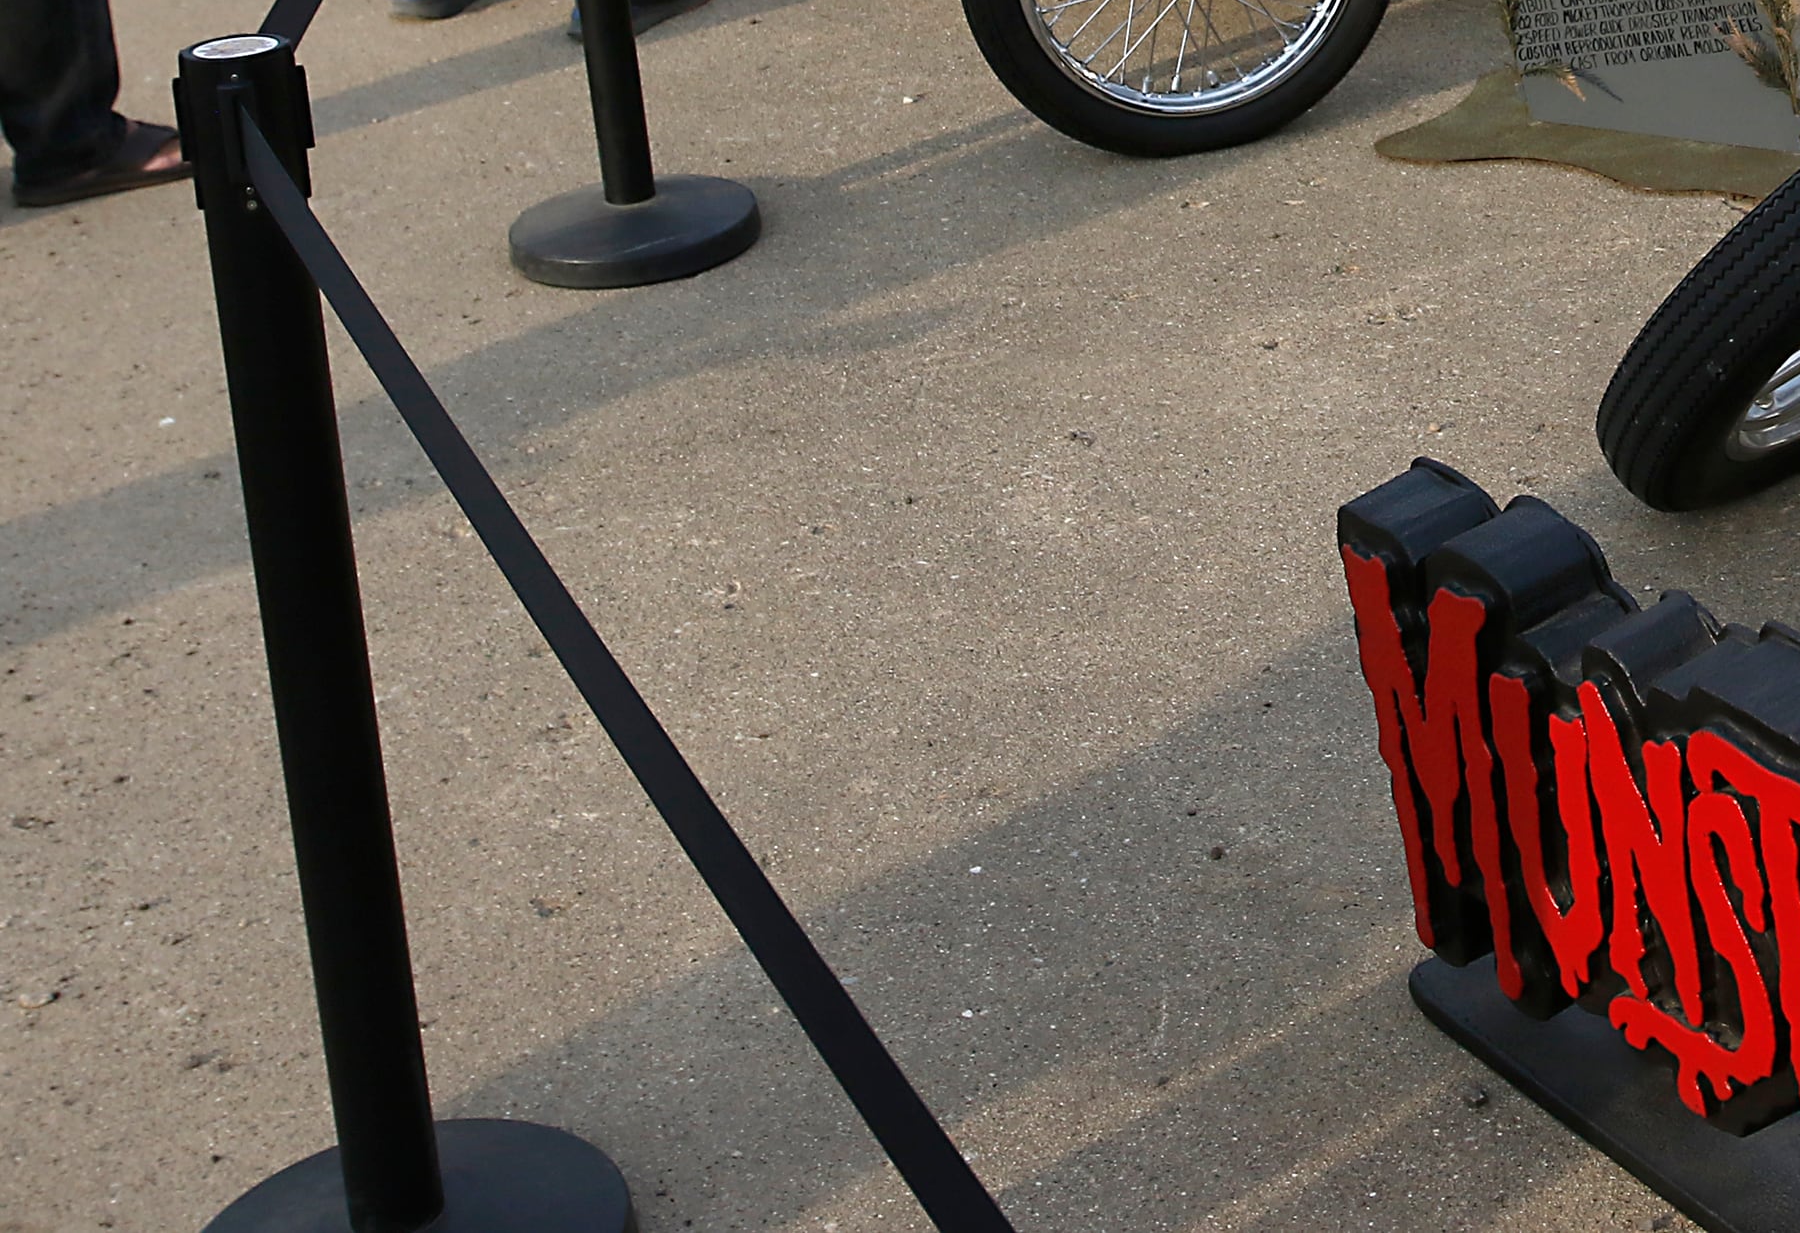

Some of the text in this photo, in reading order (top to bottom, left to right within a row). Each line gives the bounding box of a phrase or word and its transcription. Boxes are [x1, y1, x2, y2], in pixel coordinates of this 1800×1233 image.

[1535, 11, 1559, 28] FORD
[1563, 6, 1598, 24] MICKEY
[1601, 0, 1653, 18] THOMPSON
[1564, 22, 1598, 39] POWER
[1600, 18, 1623, 35] GLIDE
[1628, 11, 1679, 30] DRAGSTER
[1682, 1, 1758, 23] TRANSMISSION
[1518, 42, 1562, 62] CUSTOM
[1565, 31, 1641, 56] REPRODUCTION
[1642, 27, 1675, 46] RADIR
[1680, 21, 1712, 39] REAR
[1570, 53, 1599, 71] CAST
[1604, 49, 1636, 66] FROM
[1640, 43, 1693, 62] ORIGINAL
